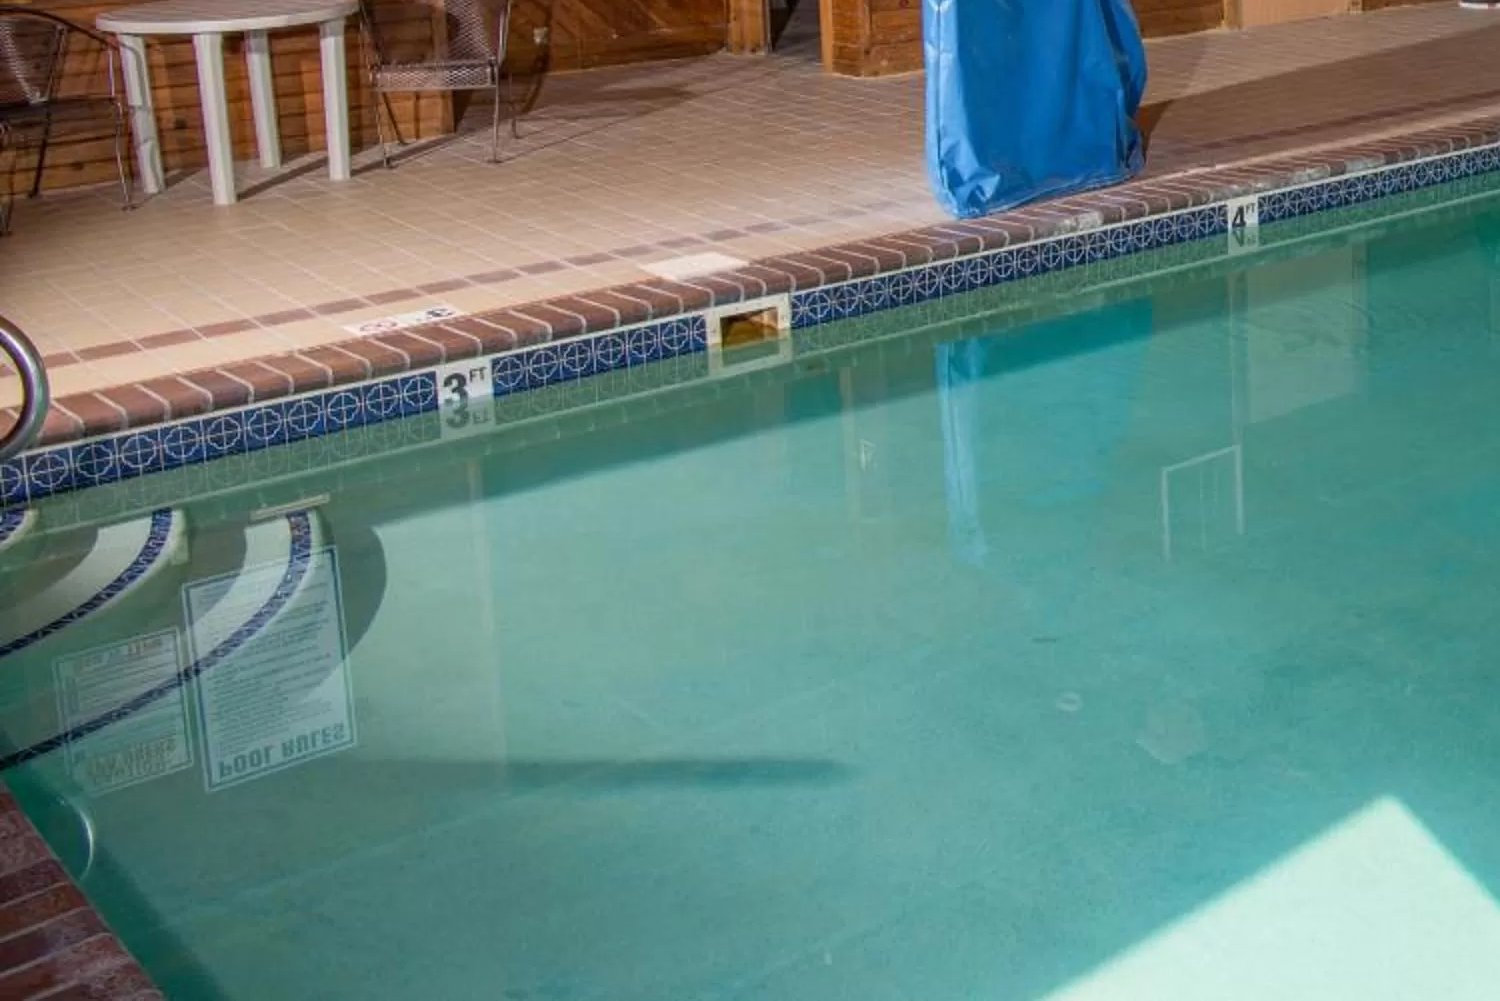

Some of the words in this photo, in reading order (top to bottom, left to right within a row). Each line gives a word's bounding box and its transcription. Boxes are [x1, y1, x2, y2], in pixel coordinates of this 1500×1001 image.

[1231, 205, 1246, 227] 4
[443, 372, 469, 401] 3
[469, 367, 487, 382] FT
